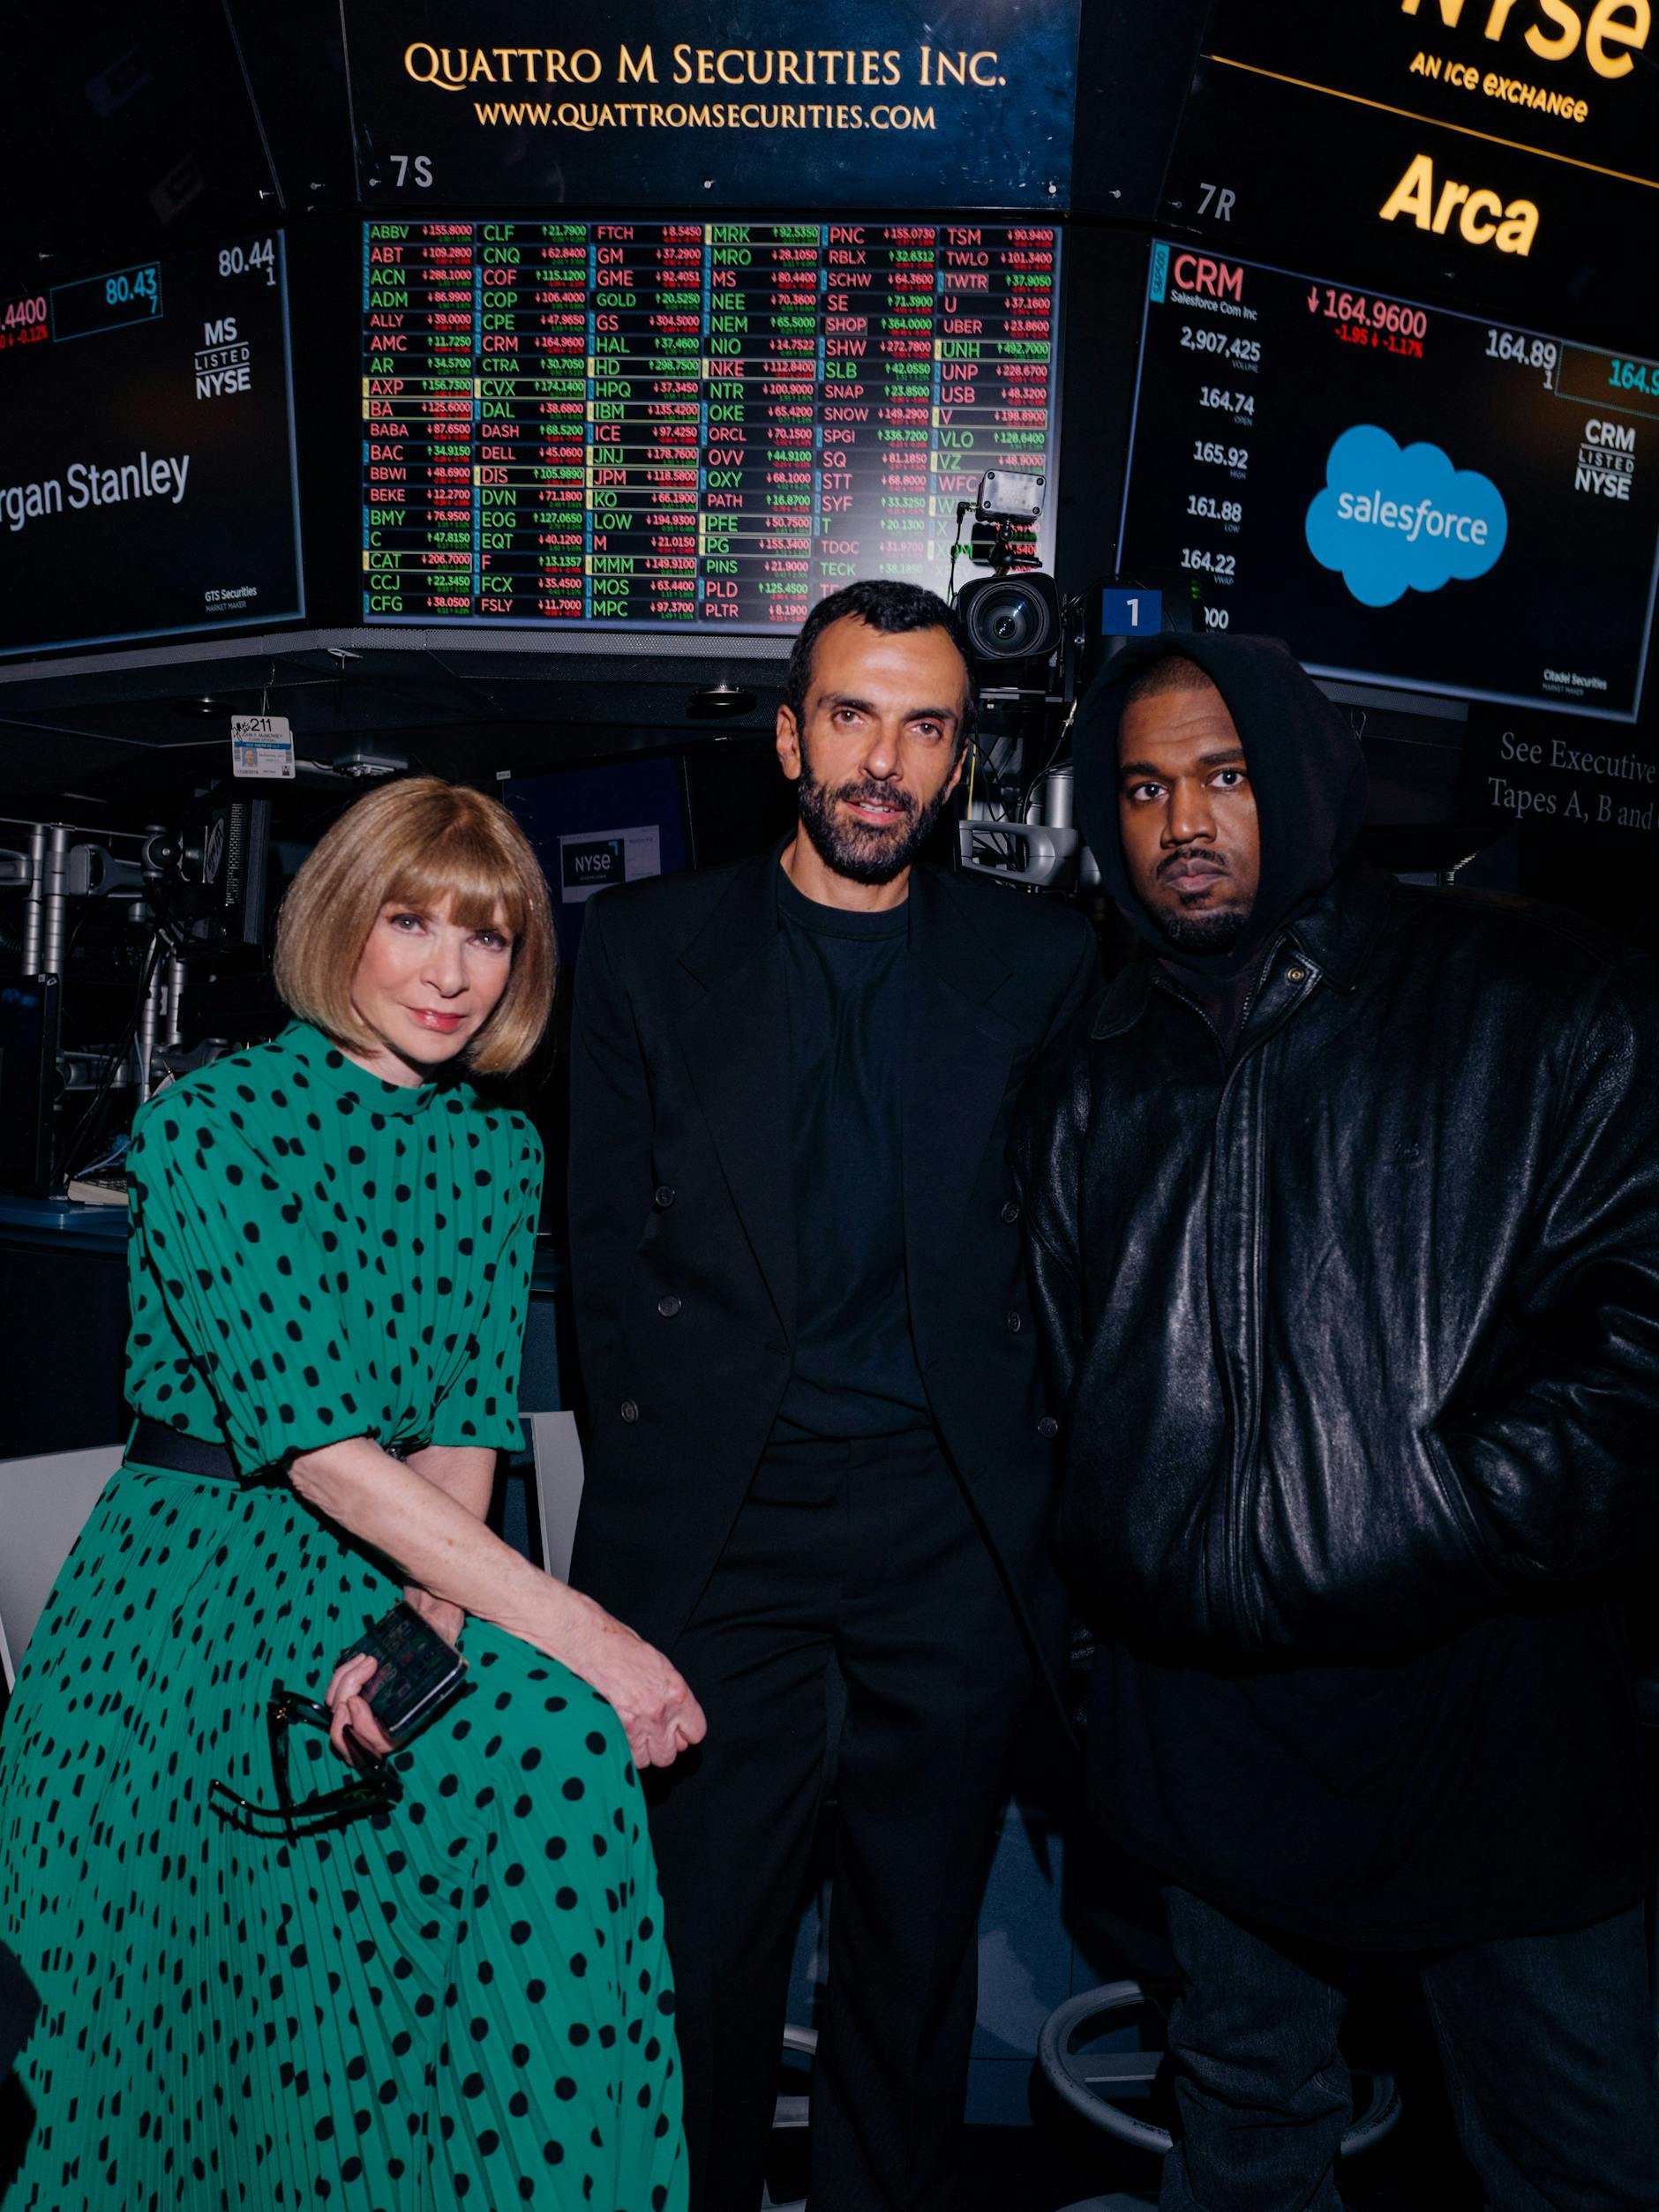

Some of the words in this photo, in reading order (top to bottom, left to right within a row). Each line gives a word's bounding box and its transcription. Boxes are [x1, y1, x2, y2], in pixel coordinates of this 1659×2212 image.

[404, 42, 602, 91] QUATTRO
[617, 46, 658, 84] M
[673, 44, 901, 86] SECURITIES
[921, 46, 1007, 86] INC.
[1410, 51, 1442, 79] AN
[474, 102, 936, 131] WWW.QUATTROMSECURITIES.COM
[389, 155, 433, 188] 7S
[1196, 182, 1236, 222] 7R
[1379, 154, 1540, 257] Arca
[371, 226, 409, 239] ABBV
[483, 225, 514, 242] CLF
[597, 226, 634, 240] FTCH
[713, 226, 749, 244] MRK
[830, 227, 864, 244] PNC
[947, 229, 981, 245] TSM
[219, 238, 275, 277] 80.44
[371, 246, 402, 263] ABT
[483, 247, 521, 264] CNQ
[597, 248, 623, 265] GM
[712, 248, 752, 266] MRO
[828, 251, 865, 265] RBLX
[946, 251, 988, 266] TWLO
[266, 266, 276, 286] 1
[371, 268, 405, 285] ACN
[484, 269, 516, 286] COF
[597, 270, 633, 287] GME
[712, 271, 735, 288] MS
[829, 273, 871, 287] SCHW
[946, 274, 987, 289] TWTR
[1174, 253, 1244, 302] CRM
[106, 268, 157, 305] 80.43
[150, 296, 158, 315] 7
[371, 291, 408, 308] ADM
[483, 291, 518, 308] COP
[596, 293, 635, 307] GOLD
[711, 293, 745, 311] NEE
[828, 294, 847, 311] SE
[1170, 289, 1219, 311] Salesforce
[370, 314, 403, 327] ALLY
[483, 313, 514, 330] CPE
[596, 314, 619, 331] GS
[1324, 289, 1428, 340] 164.9600
[205, 317, 238, 347] MS
[711, 316, 748, 333] NEM
[826, 317, 867, 333] SHOP
[942, 319, 981, 334] UBER
[371, 335, 406, 351] AMC
[483, 335, 518, 352] CRM
[596, 337, 629, 353] HAL
[710, 339, 741, 354] NIO
[827, 339, 867, 356] SHW
[1180, 326, 1262, 363] 2,907,425
[1485, 329, 1558, 371] 164.89
[195, 347, 250, 371] LISTED
[370, 356, 394, 372] AR
[482, 357, 518, 371] CTRA
[596, 358, 620, 377] HD
[709, 361, 744, 379] NKE
[826, 361, 857, 379] SLB
[942, 364, 978, 380] UNP
[196, 366, 251, 400] NYSE
[371, 379, 403, 395] AXP
[1543, 370, 1553, 390] 1
[483, 380, 515, 398] CVX
[596, 381, 631, 398] HPQ
[709, 382, 744, 399] NTR
[825, 385, 862, 398] SNAP
[942, 386, 974, 403] USB
[371, 401, 393, 417] BA
[482, 401, 514, 418] DAL
[1199, 387, 1255, 416] 164.74
[595, 403, 625, 421] IBM
[709, 405, 744, 422] OKE
[824, 408, 868, 421] SNOW
[370, 423, 408, 437] BABA
[482, 424, 519, 438] DASH
[595, 425, 620, 442] ICE
[709, 427, 746, 441] ORCL
[1585, 418, 1636, 453] CRM
[940, 431, 974, 448] VLO
[371, 445, 403, 461] BAC
[481, 446, 515, 461] DELL
[708, 449, 743, 466] OVV
[823, 452, 846, 468] SQ
[1193, 440, 1249, 469] 165.92
[1578, 448, 1634, 474] LISTED
[67, 451, 190, 510] Stanley
[370, 467, 406, 480] BBWI
[482, 467, 508, 484] DIS
[594, 469, 627, 485] JPM
[709, 470, 741, 488] OXY
[822, 473, 852, 491] STT
[938, 476, 976, 491] WFC
[1574, 468, 1633, 501] NYSE
[370, 488, 404, 502] BEKE
[482, 489, 517, 506] DVN
[594, 491, 617, 508] KO
[707, 494, 742, 506] PATH
[822, 495, 852, 512] SYF
[1187, 494, 1242, 523] 161.88
[371, 509, 406, 526] BMY
[481, 511, 516, 528] EOG
[593, 514, 632, 529] LOW
[706, 515, 738, 533] PFE
[1337, 490, 1489, 546] salesforce
[481, 532, 513, 549] EQT
[706, 536, 730, 554] PG
[821, 540, 860, 554] TDOC
[371, 551, 402, 570] CAT
[594, 557, 633, 574] MMM
[706, 559, 738, 574] PINS
[1181, 547, 1236, 575] 164.22
[370, 574, 400, 590] CCJ
[482, 575, 512, 593] FCX
[593, 579, 629, 596] MOS
[706, 581, 738, 598] PLD
[205, 589, 220, 602] GTS
[221, 586, 257, 600] Securities
[371, 595, 402, 611] CFG
[480, 598, 512, 612] FSLY
[593, 600, 627, 617] MPC
[706, 604, 738, 617] PLTR
[1127, 598, 1139, 626] 1
[251, 717, 272, 732] 211
[1501, 731, 1543, 765] See
[1550, 739, 1656, 784] Executive
[1488, 776, 1557, 819] Tapes
[1596, 794, 1612, 822] B
[1618, 802, 1655, 830] and
